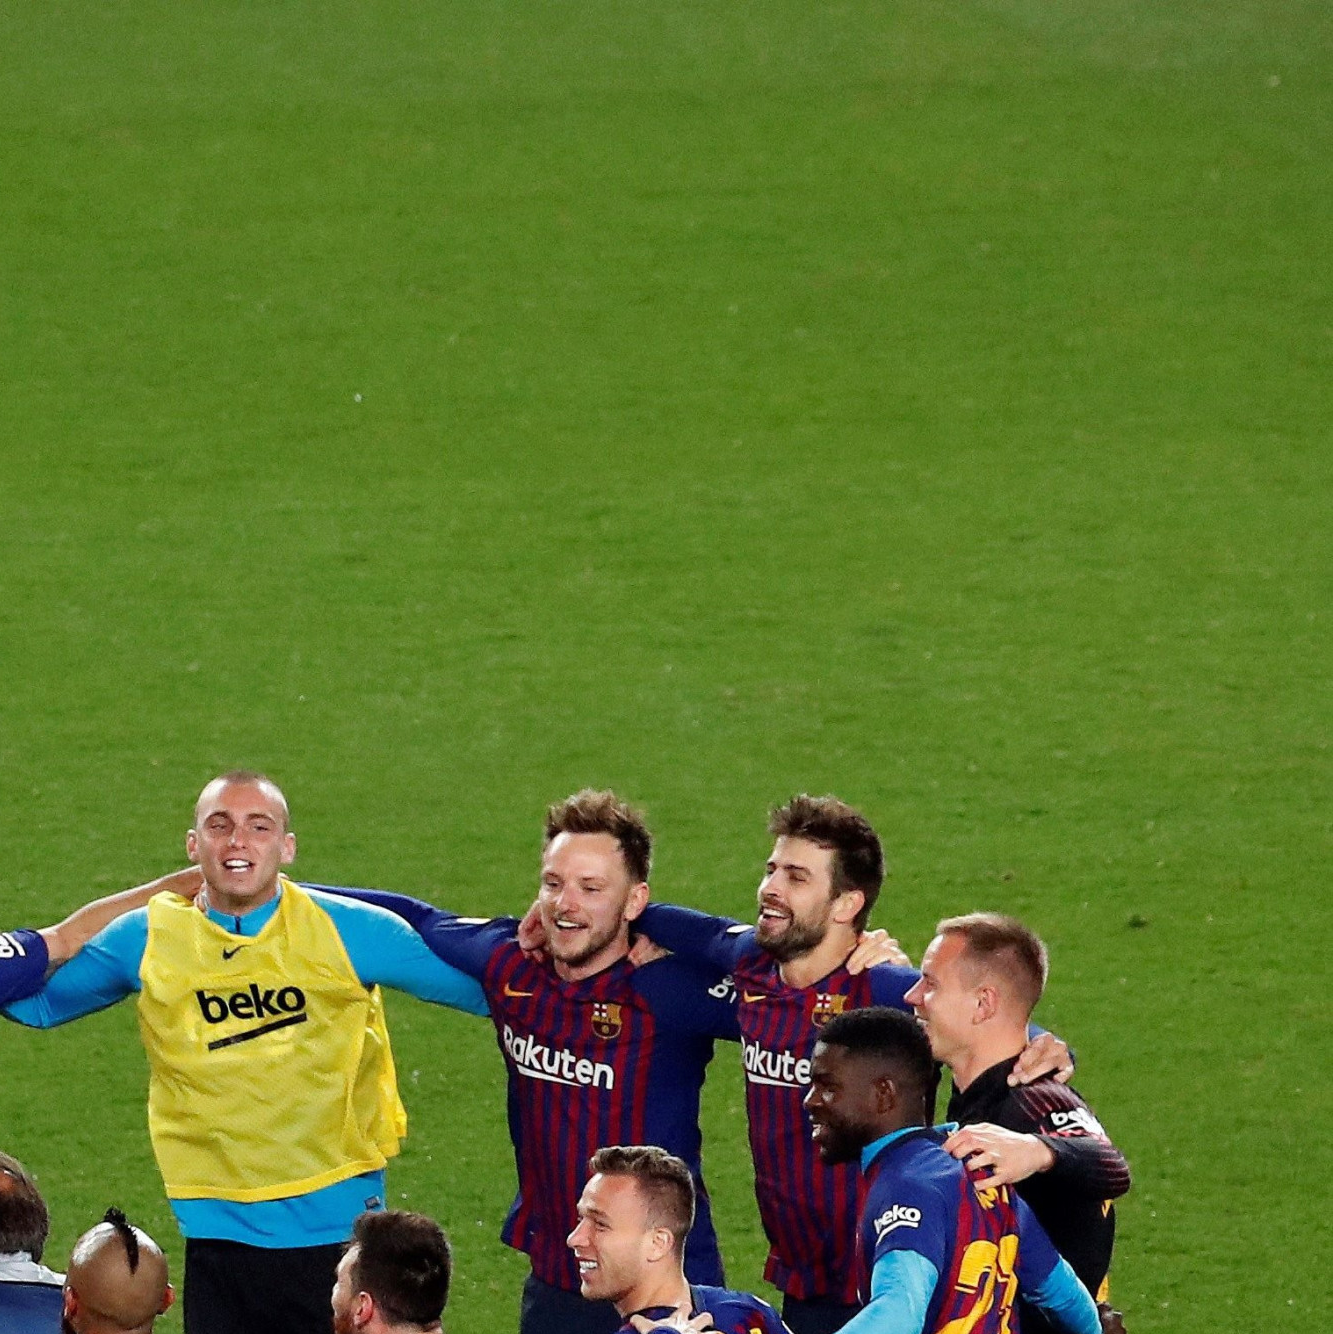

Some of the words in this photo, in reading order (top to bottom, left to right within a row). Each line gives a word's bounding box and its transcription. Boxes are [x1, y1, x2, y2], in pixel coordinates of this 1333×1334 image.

[196, 984, 306, 1024] beko
[503, 1023, 614, 1090] Rakuten
[741, 1035, 812, 1085] akute
